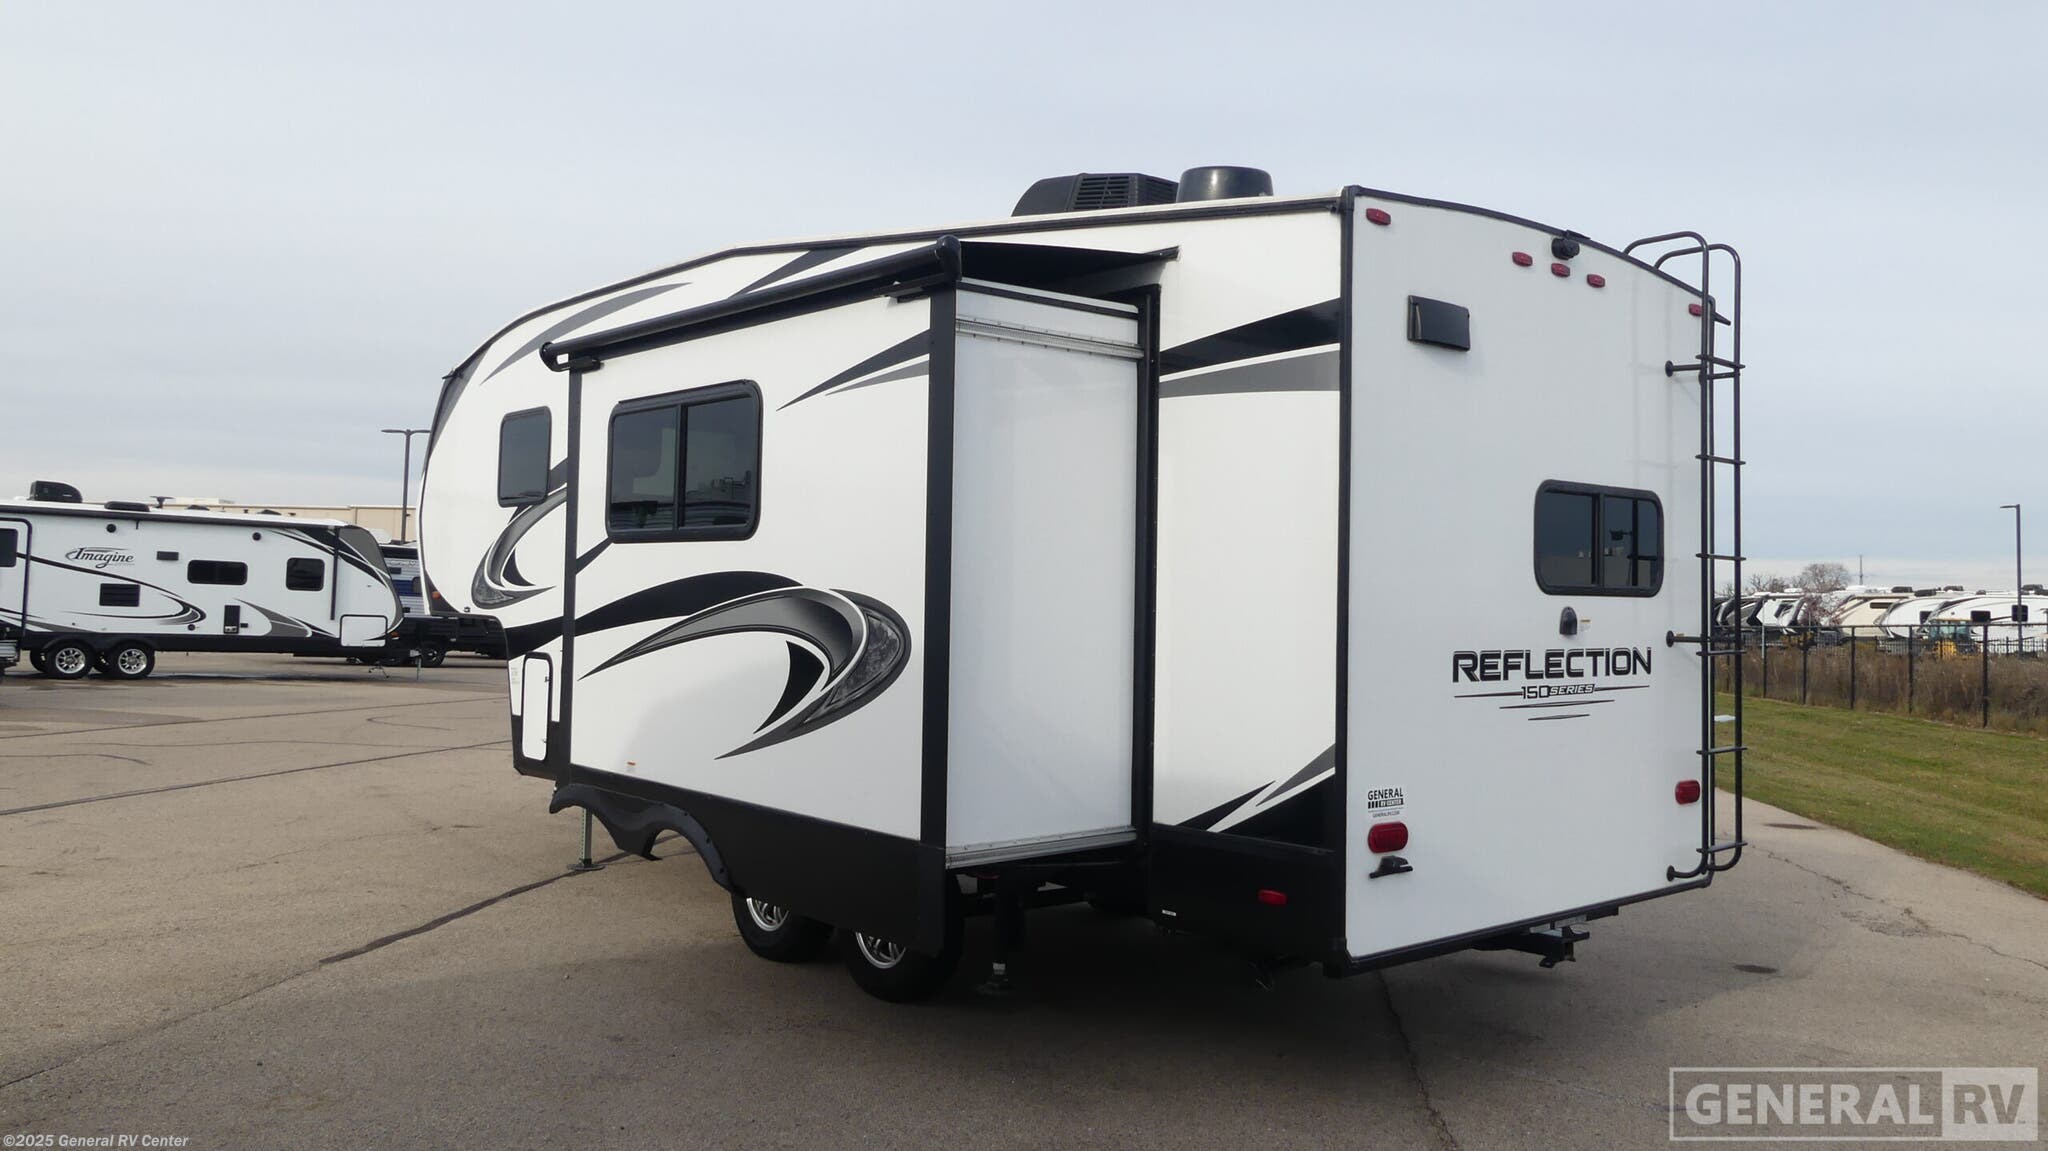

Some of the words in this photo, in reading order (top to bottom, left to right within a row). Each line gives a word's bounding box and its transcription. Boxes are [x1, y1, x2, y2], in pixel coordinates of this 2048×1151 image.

[72, 547, 134, 568] Imagine
[1452, 647, 1652, 683] REFLECTION
[1367, 787, 1404, 801] GENERAL
